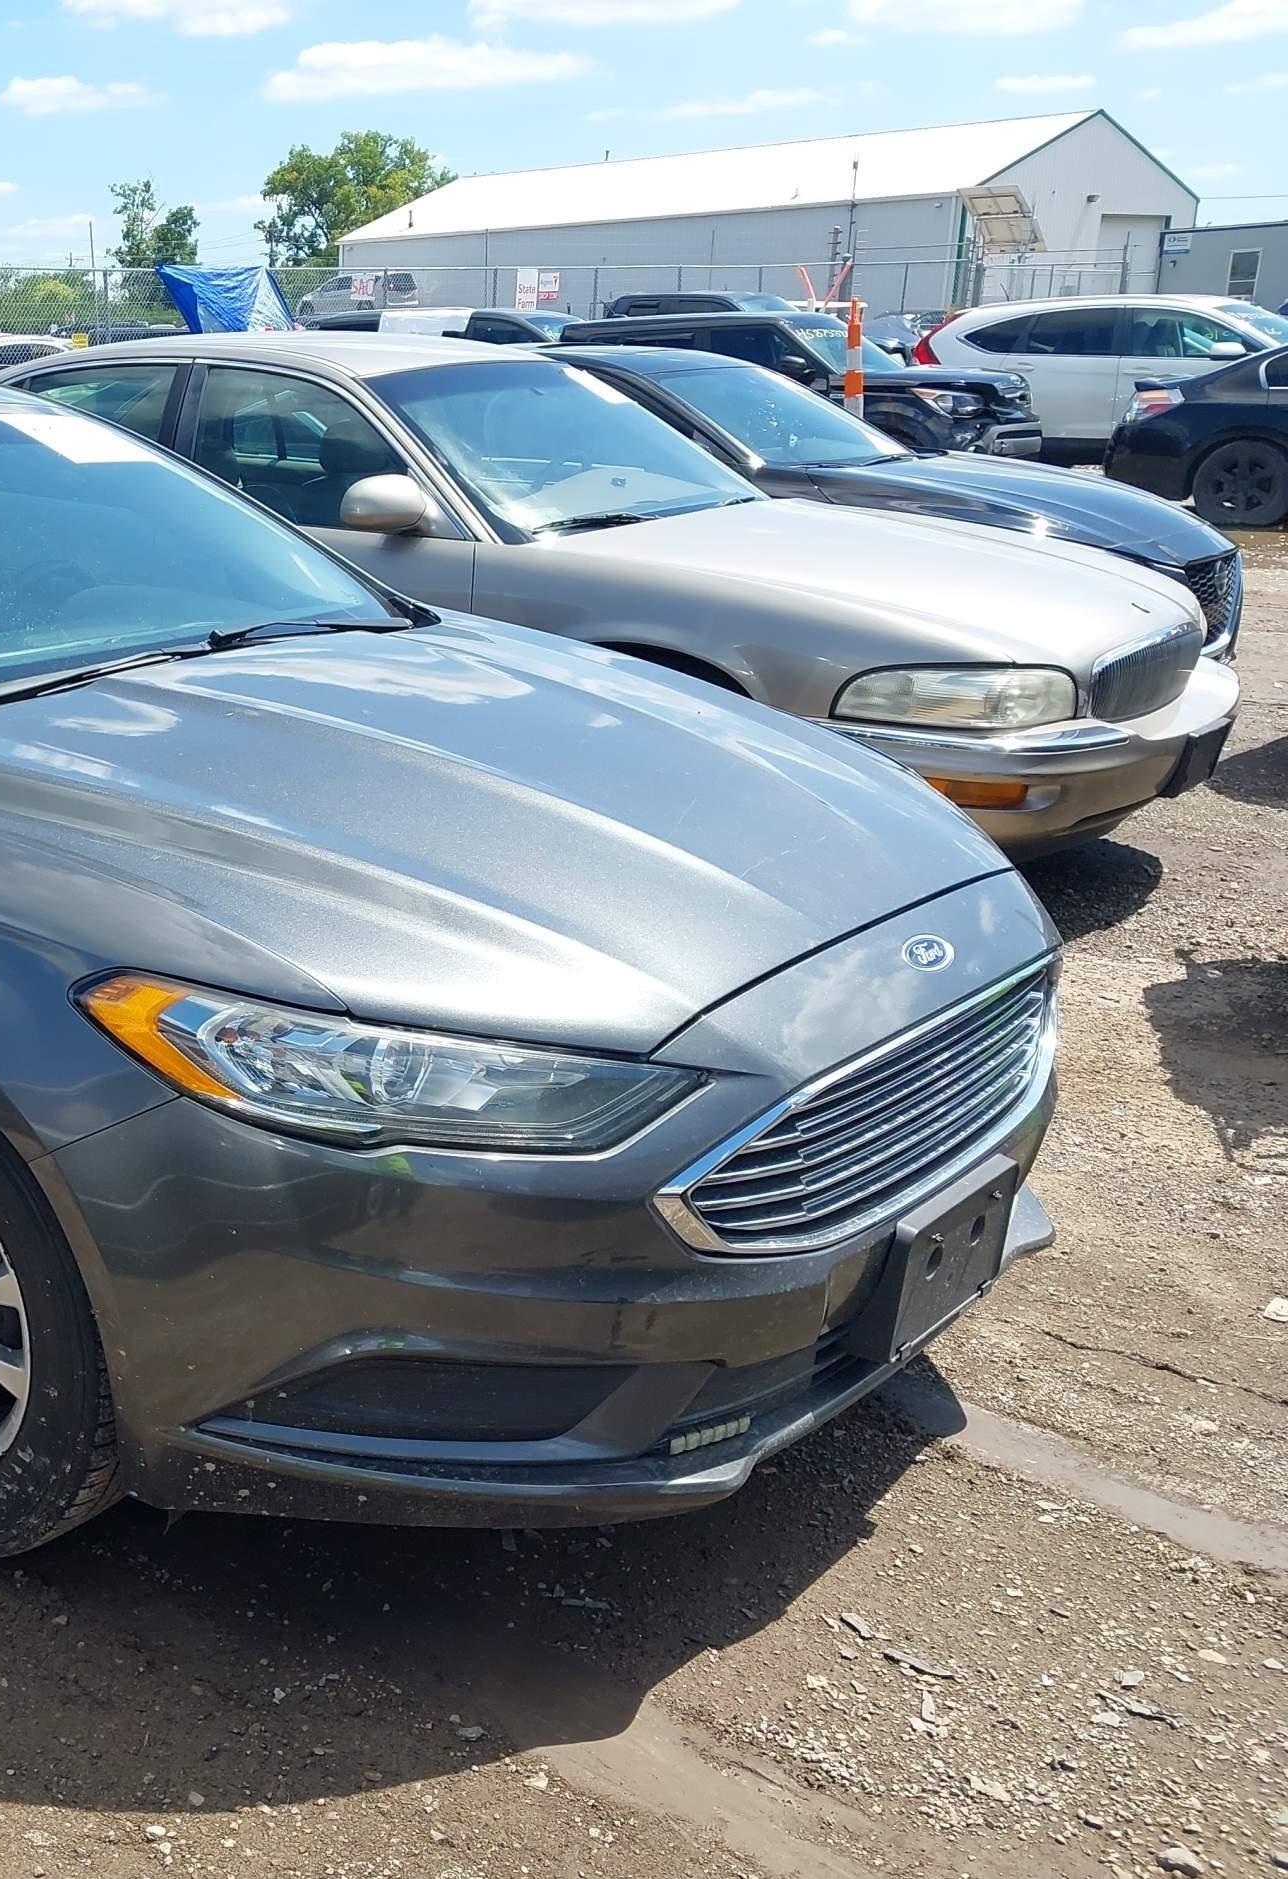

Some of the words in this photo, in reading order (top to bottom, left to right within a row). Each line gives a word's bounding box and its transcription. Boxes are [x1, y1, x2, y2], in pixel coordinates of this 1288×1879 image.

[518, 283, 536, 294] State
[518, 298, 535, 309] Farm
[913, 941, 943, 964] Ford
